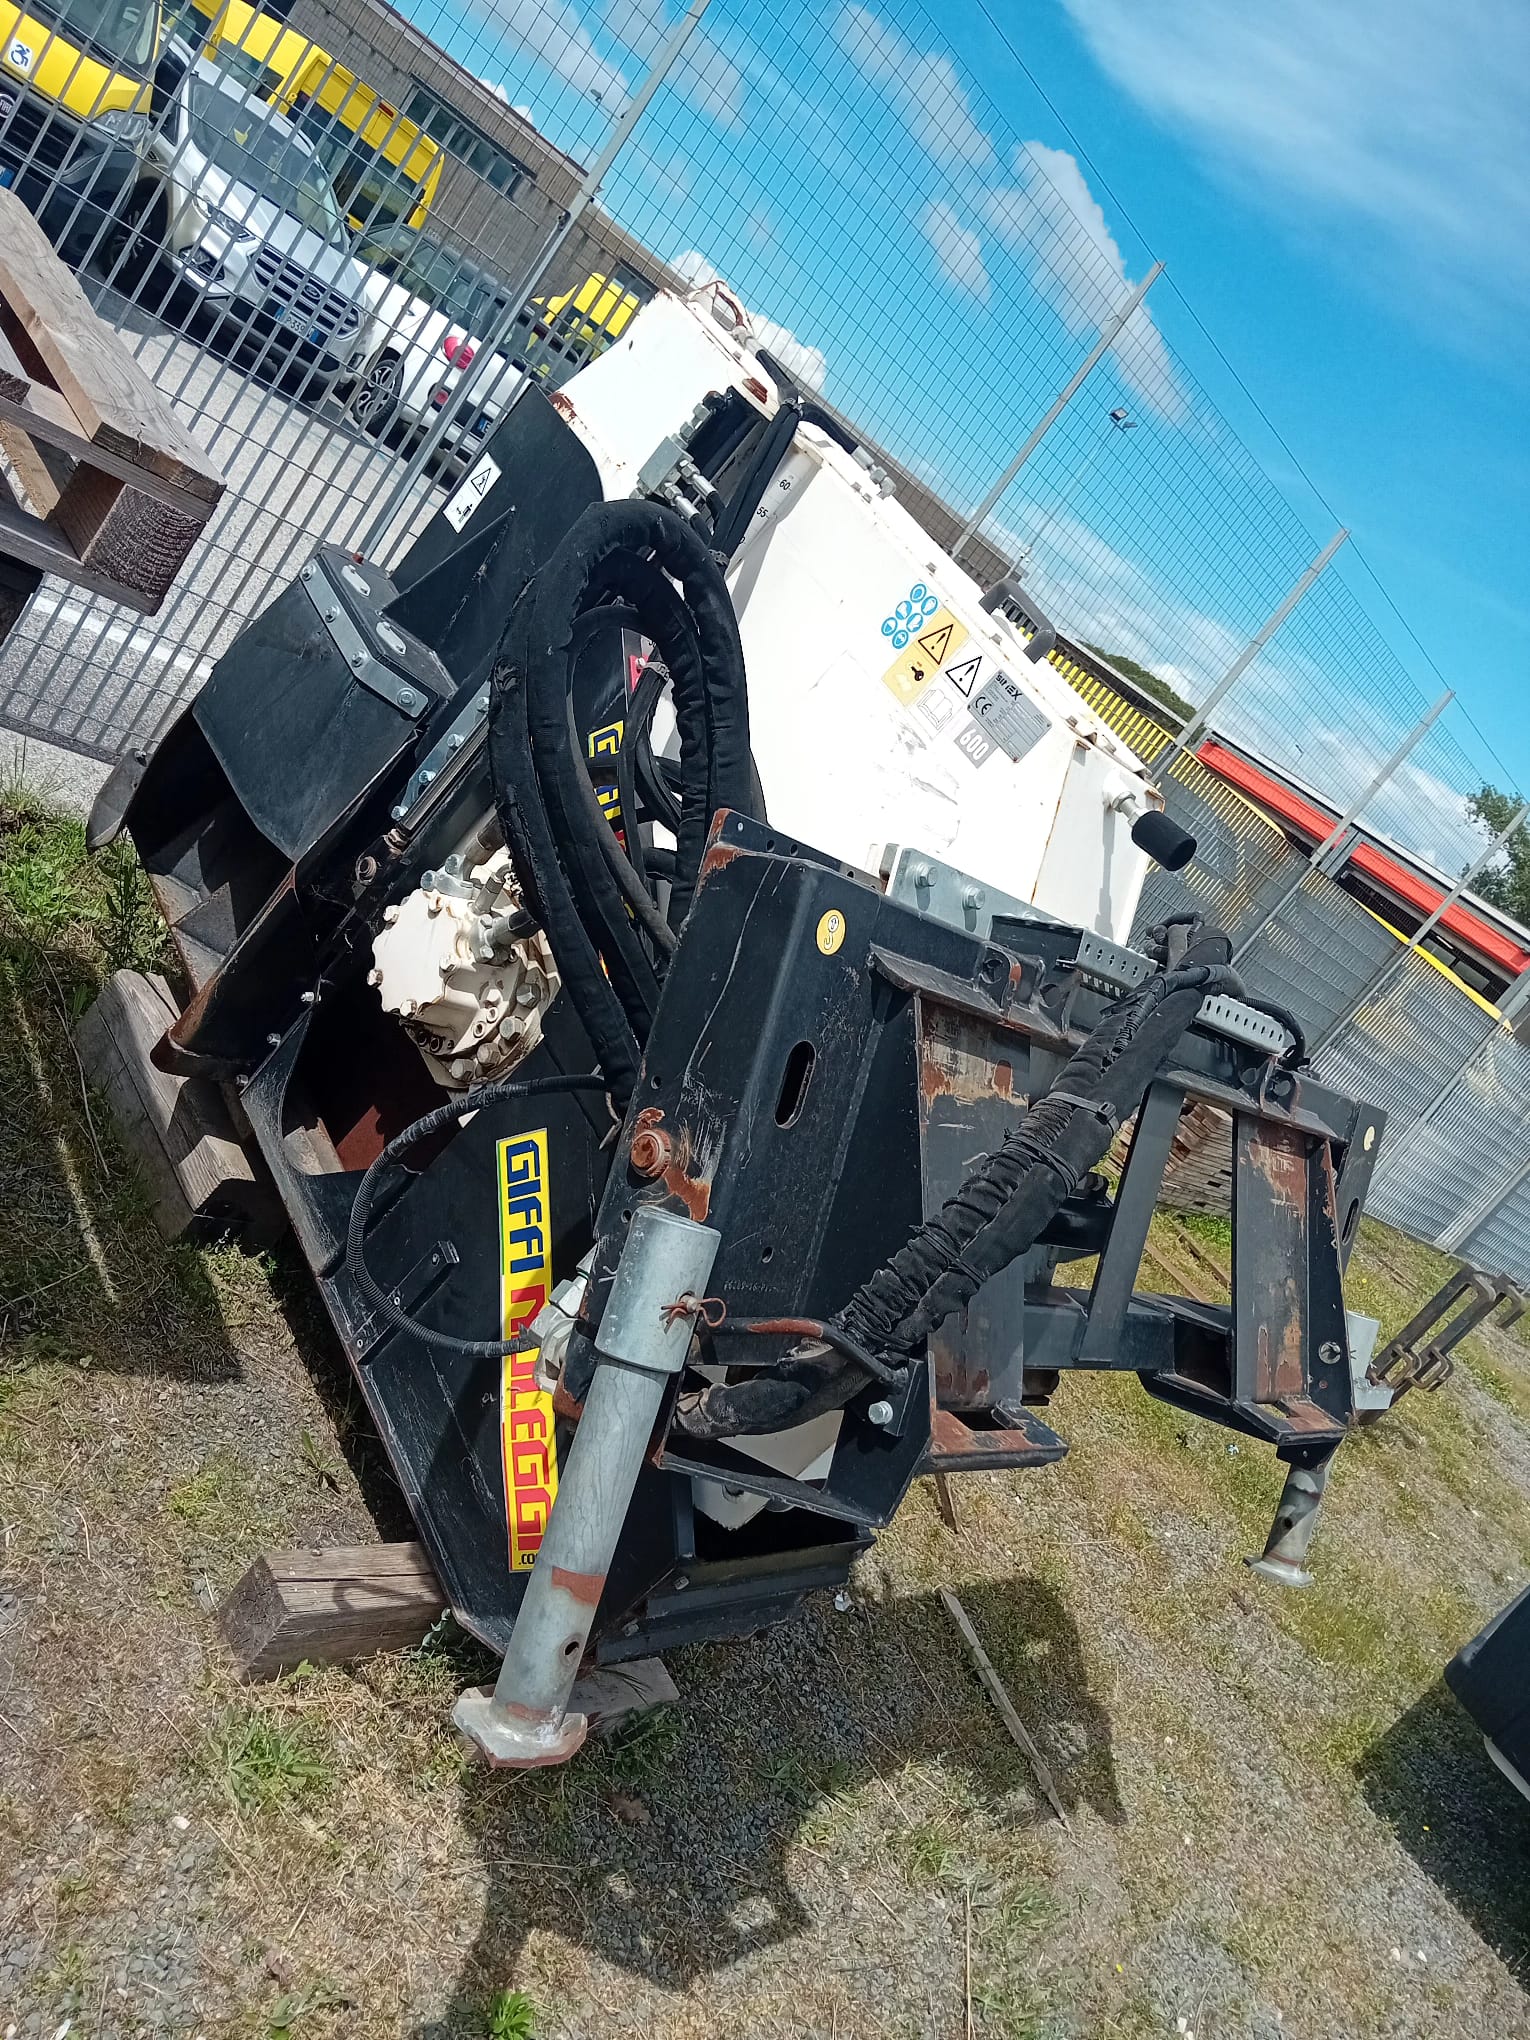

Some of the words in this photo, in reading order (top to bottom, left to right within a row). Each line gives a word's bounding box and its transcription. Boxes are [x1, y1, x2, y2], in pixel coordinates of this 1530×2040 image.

[779, 479, 791, 491] 60
[756, 506, 769, 518] 55
[959, 728, 990, 761] 600
[506, 1139, 545, 1274] GIFFI
